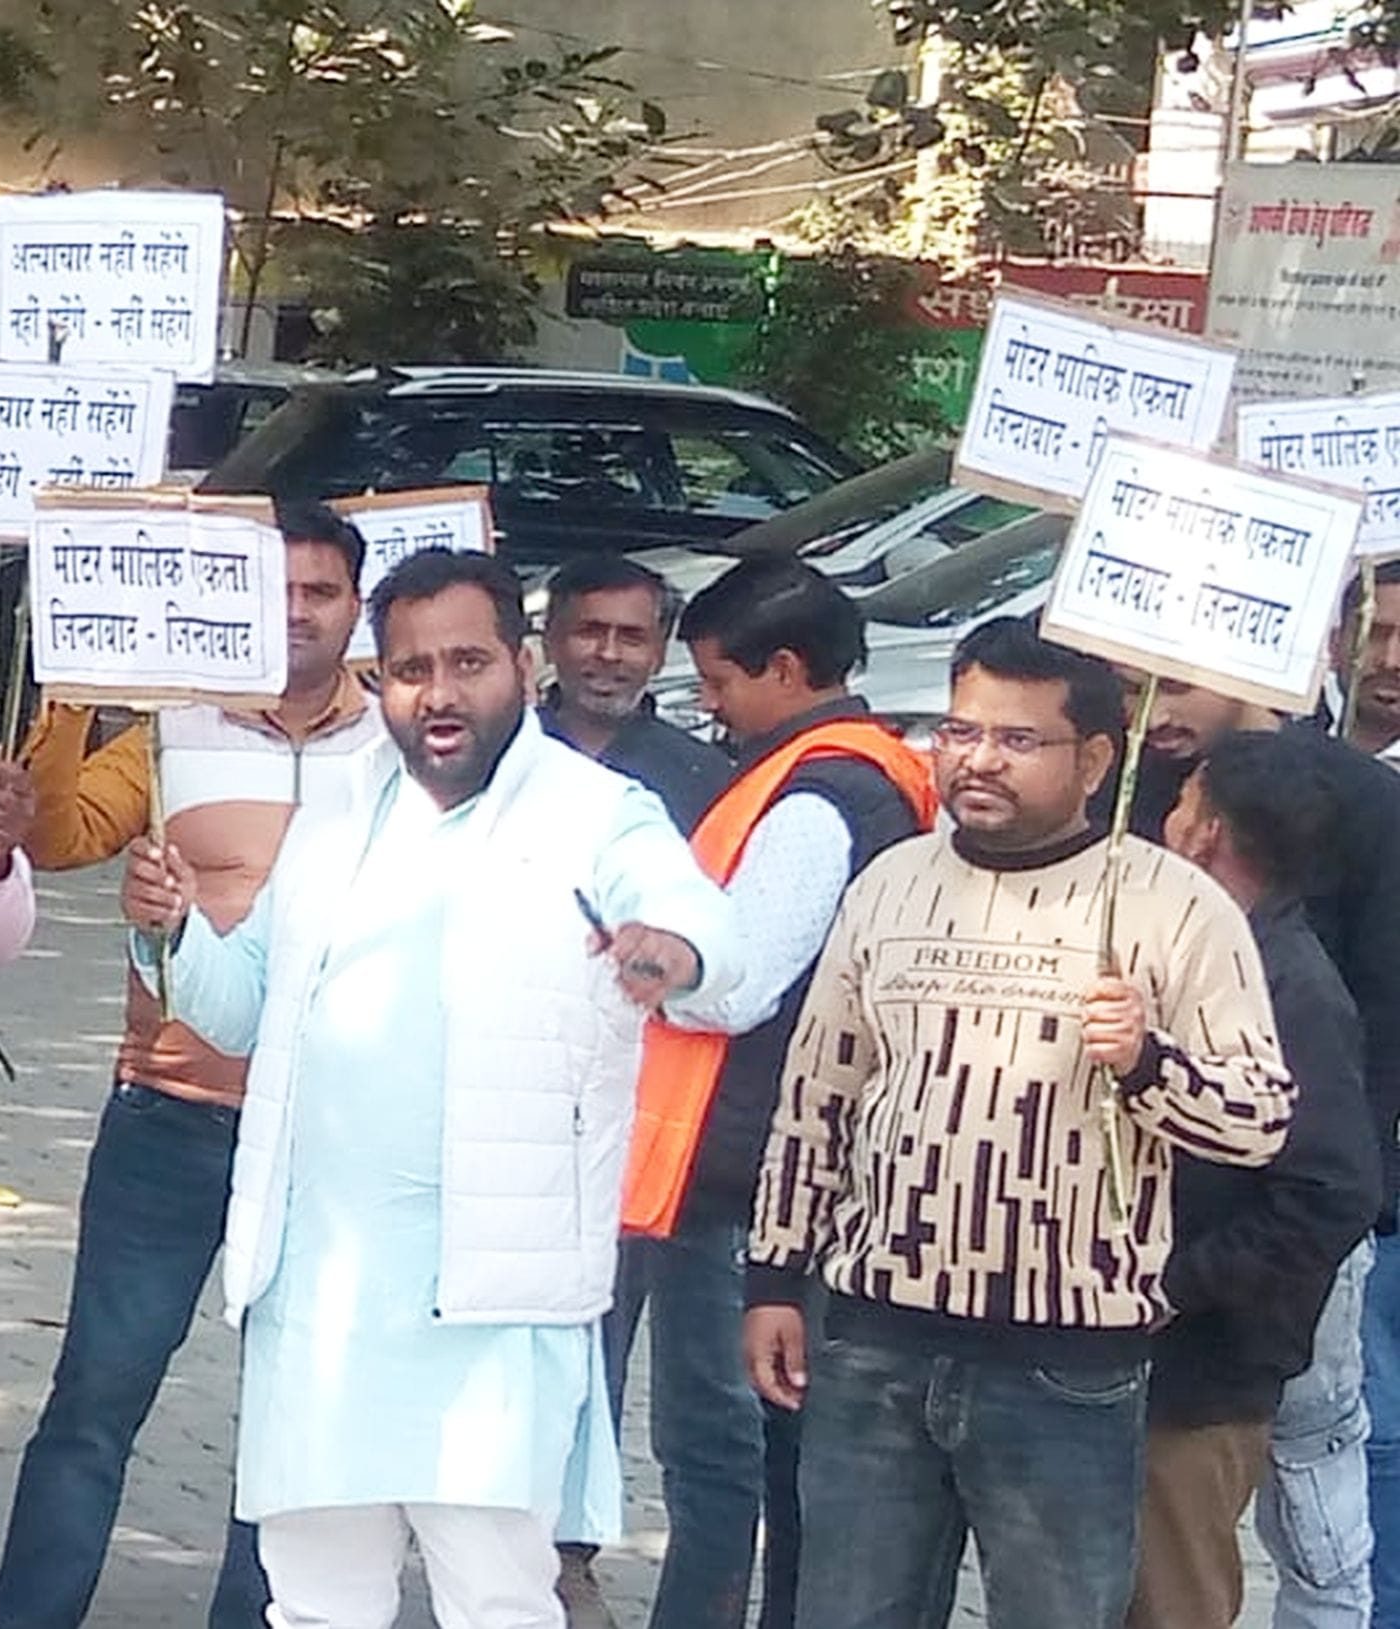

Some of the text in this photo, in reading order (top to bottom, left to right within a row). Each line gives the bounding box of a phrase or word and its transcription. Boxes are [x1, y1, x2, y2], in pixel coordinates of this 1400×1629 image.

[12, 230, 190, 280] अत्याचार नहीं सहेंगे
[9, 295, 40, 347] नहीं
[111, 295, 144, 345] नहीं
[151, 295, 193, 345] सहेंगे
[1004, 325, 1050, 387] मोटर
[1054, 345, 1127, 406] मालिक
[1130, 372, 1193, 420] एकता
[41, 387, 80, 436] नहीं
[88, 389, 136, 439] सहेंगे
[1261, 420, 1306, 472] मोटर
[1311, 415, 1379, 467] मालिक
[1111, 468, 1162, 523] मोटर
[1244, 517, 1312, 569] एकता
[53, 529, 249, 595] मोटर मालिक एकता
[913, 946, 1060, 975] FREEDOM
